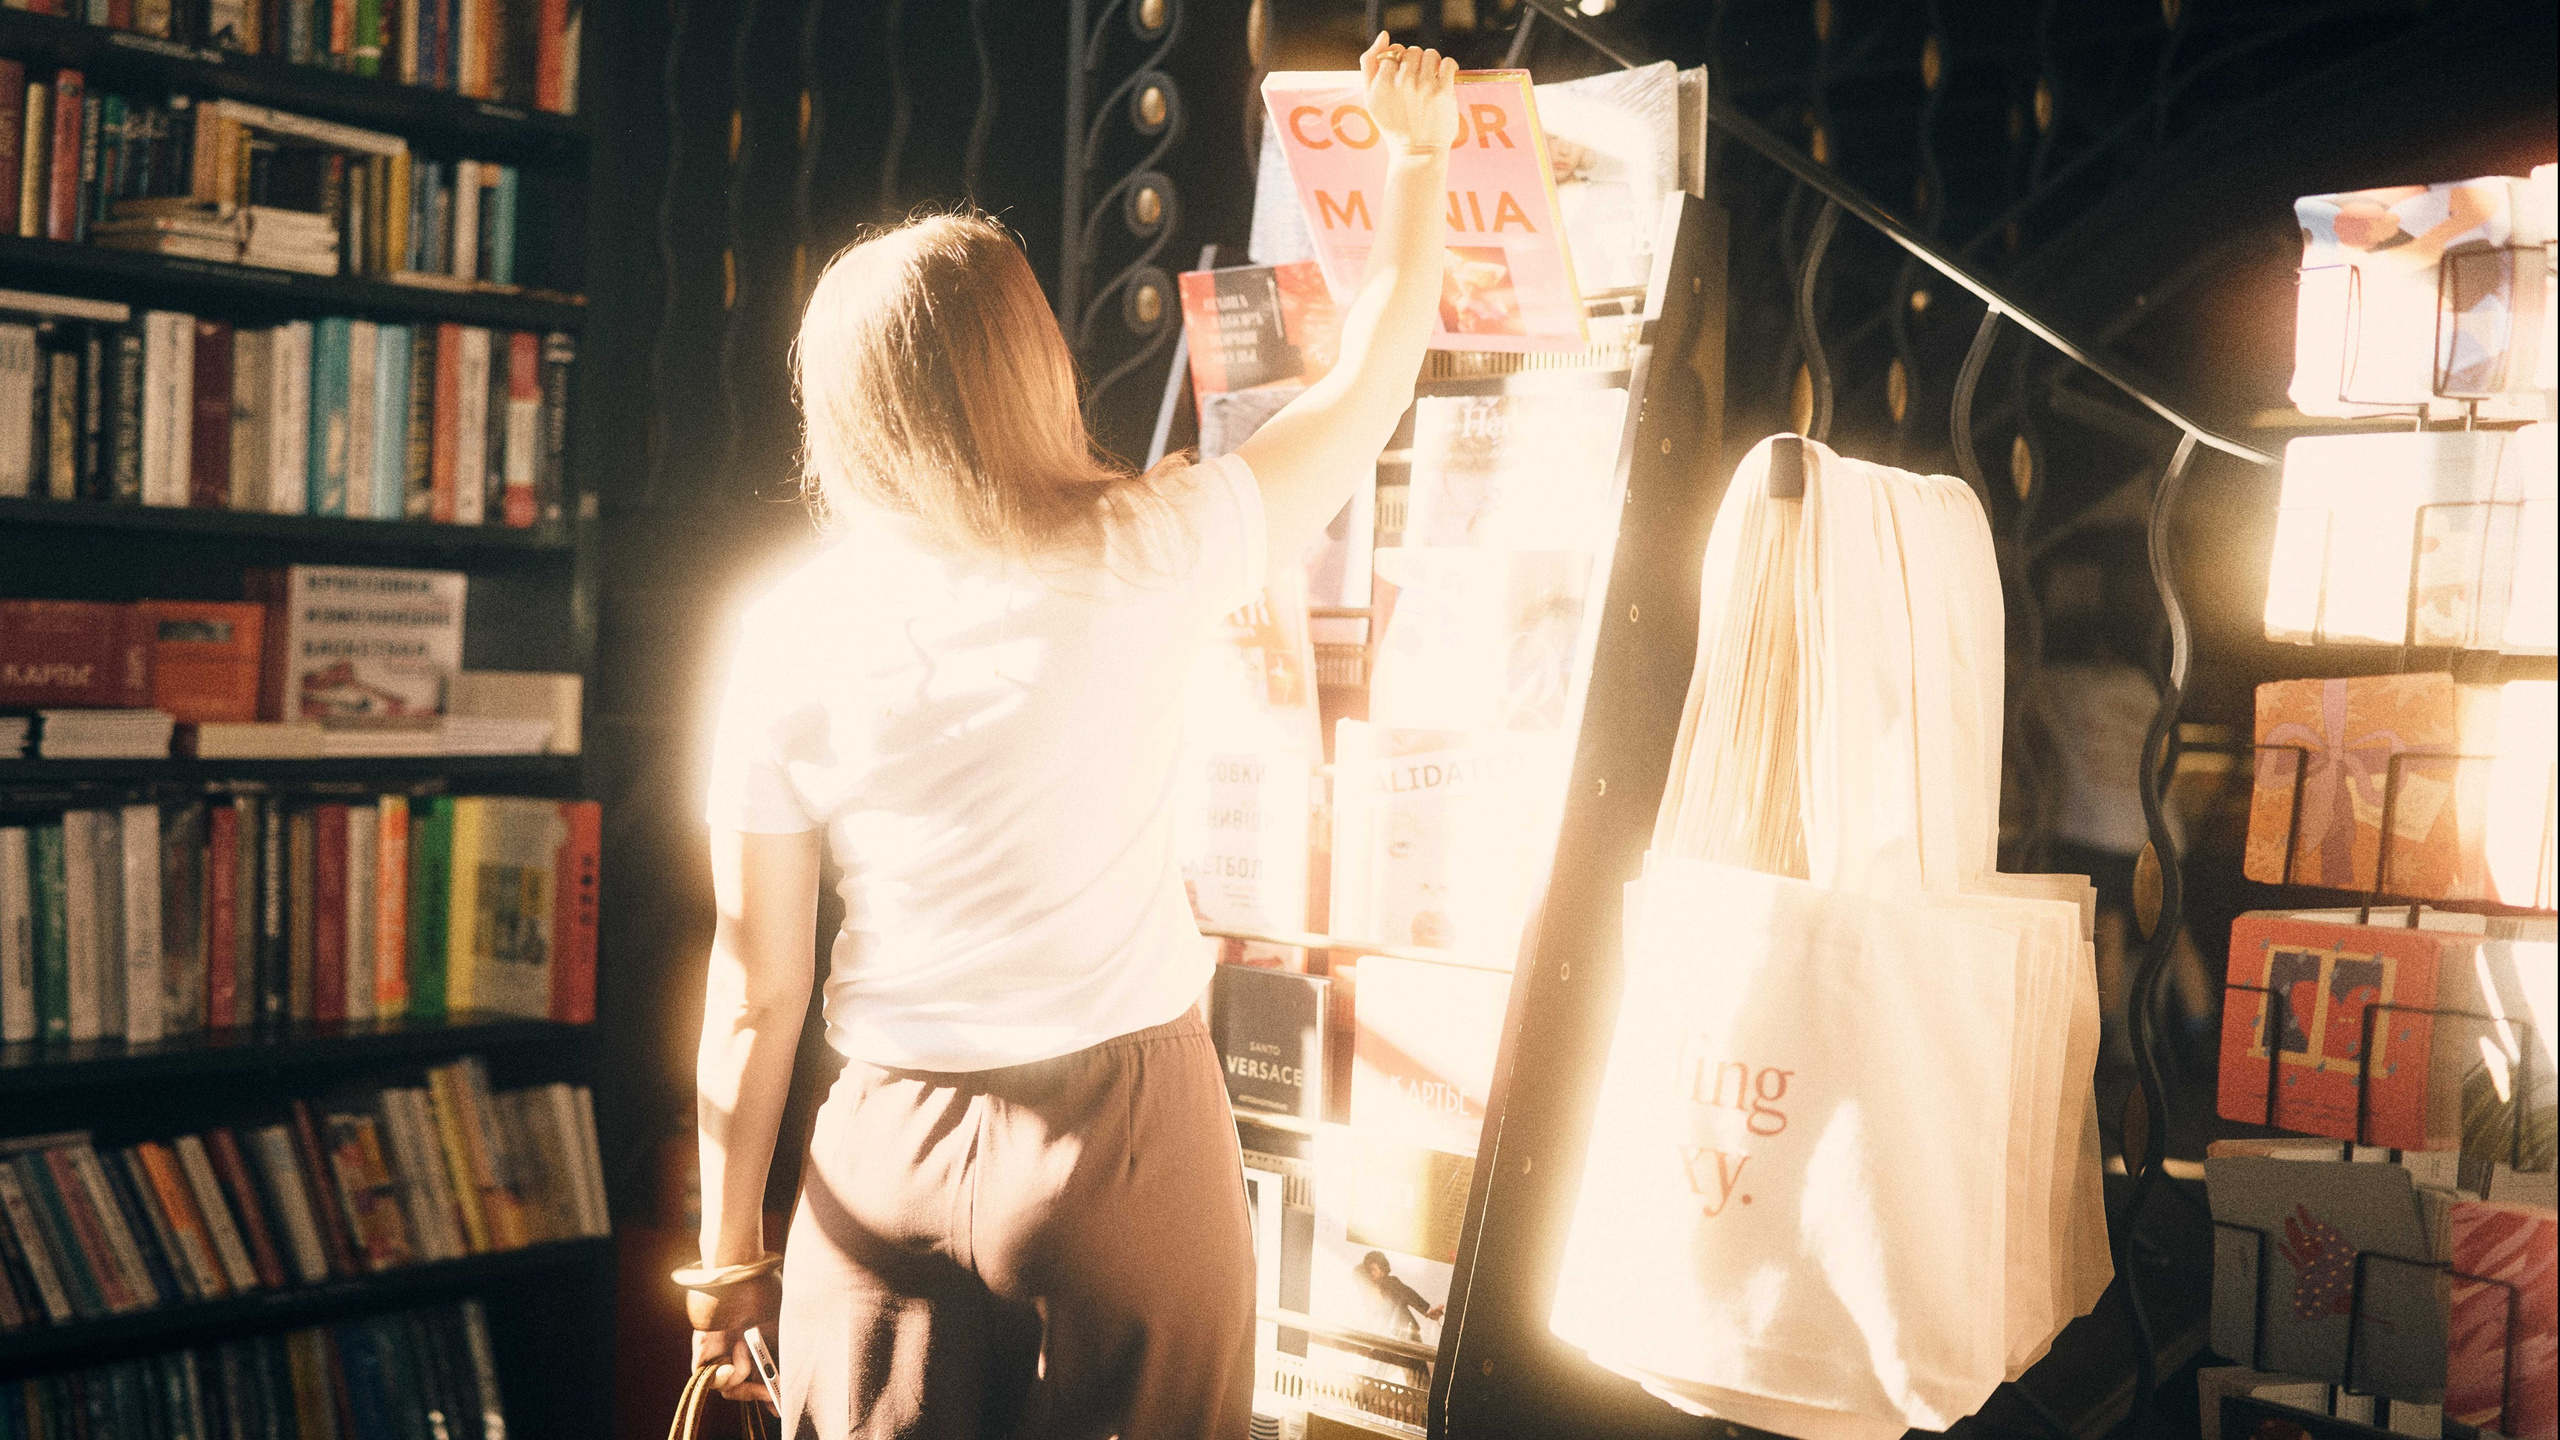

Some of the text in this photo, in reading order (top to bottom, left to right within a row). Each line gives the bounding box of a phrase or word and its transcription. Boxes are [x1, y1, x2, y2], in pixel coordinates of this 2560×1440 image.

[1287, 104, 1516, 151] COR
[1314, 189, 1537, 233] MNIA
[1249, 1041, 1282, 1057] SANTO
[1226, 1054, 1304, 1088] VERSACE
[1390, 1074, 1471, 1116] КАРТЬЕ
